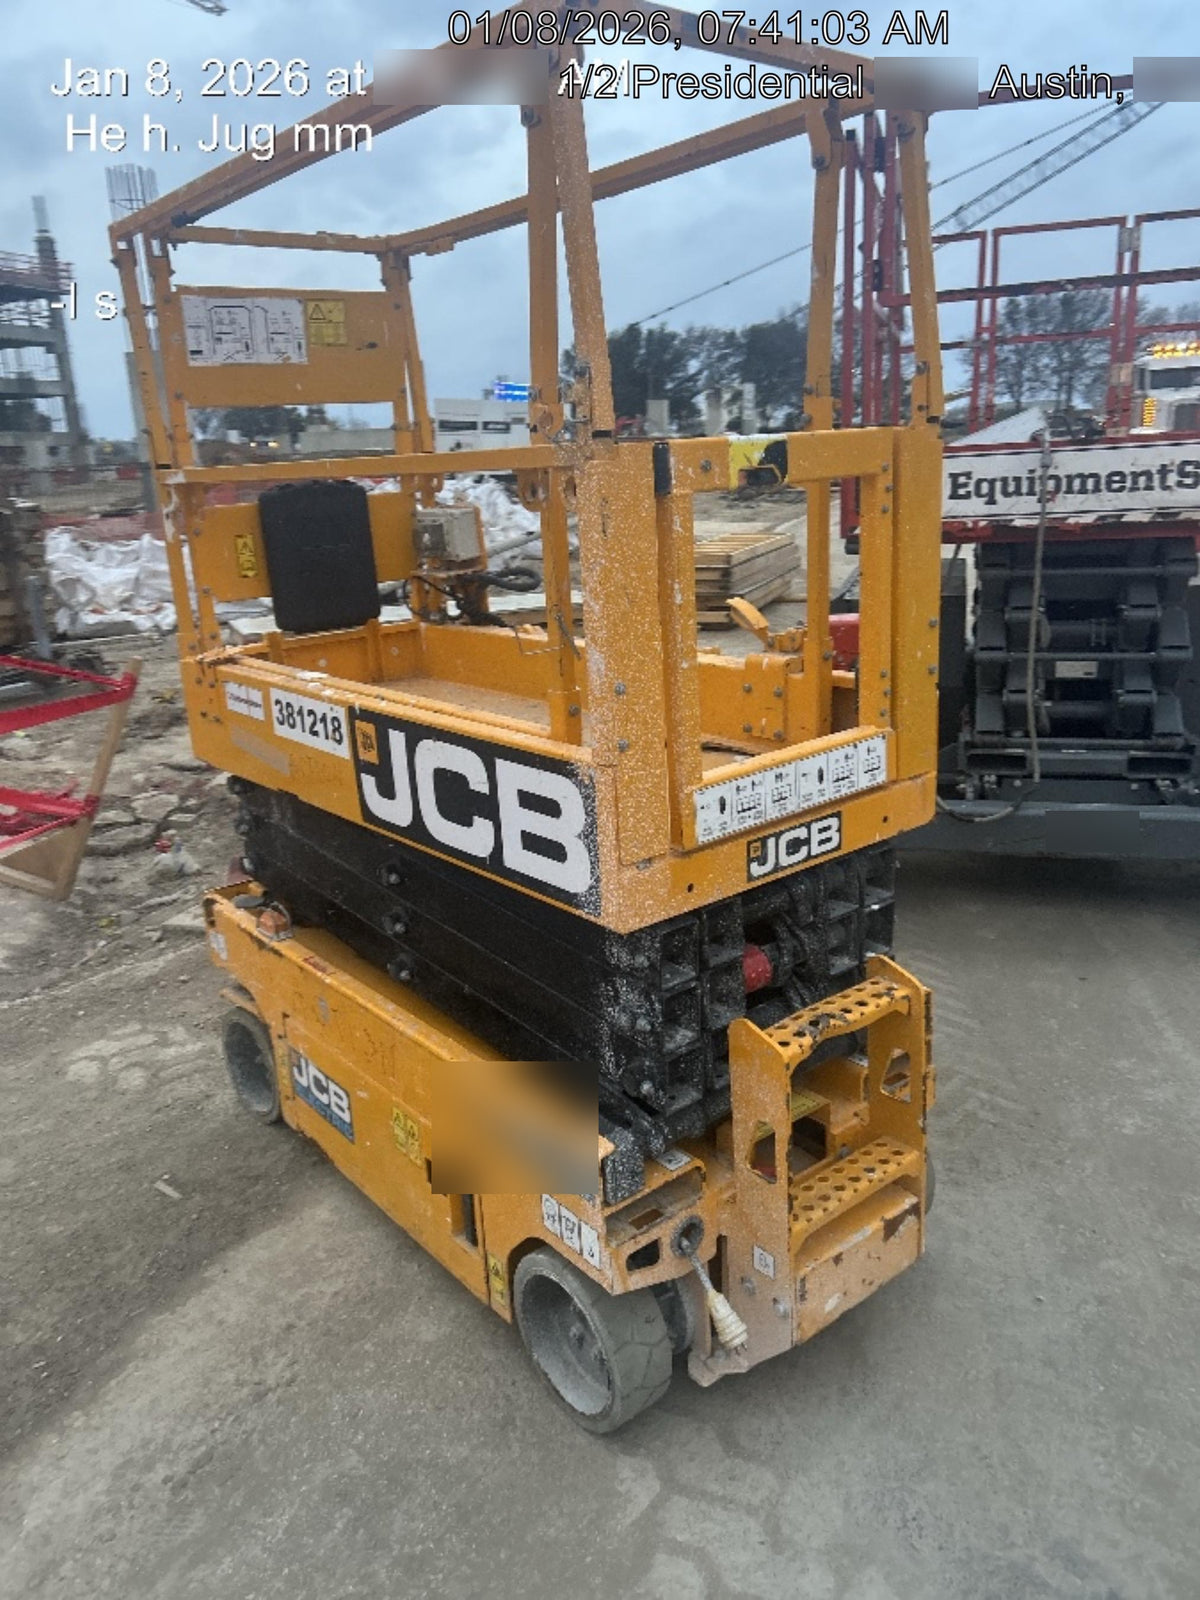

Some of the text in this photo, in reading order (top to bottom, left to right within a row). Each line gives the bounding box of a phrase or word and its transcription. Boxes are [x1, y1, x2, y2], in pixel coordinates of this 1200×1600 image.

[275, 699, 343, 745] 381218
[361, 729, 591, 893] JCB
[750, 816, 841, 878] JCB
[293, 1058, 351, 1124] JCB
